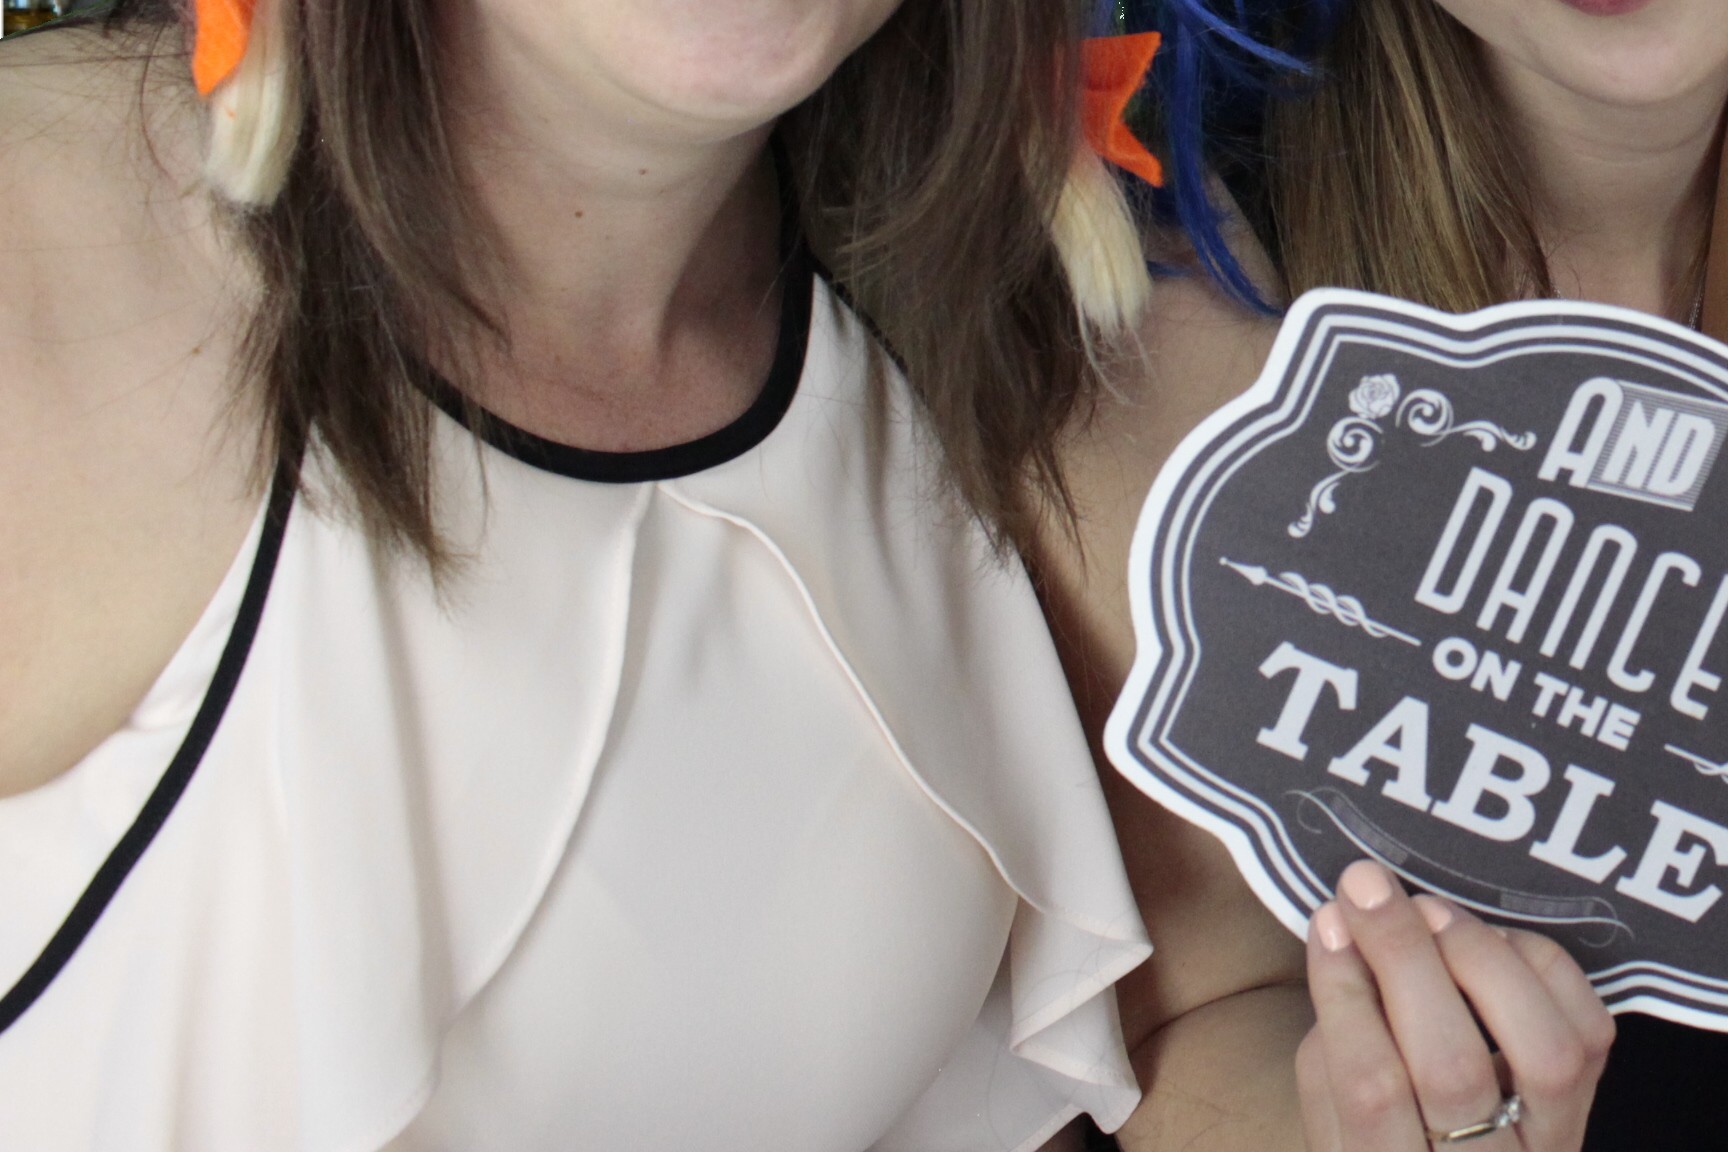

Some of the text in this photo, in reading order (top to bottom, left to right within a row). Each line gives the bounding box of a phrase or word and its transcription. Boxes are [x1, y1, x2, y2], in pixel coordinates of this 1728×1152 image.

[1537, 376, 1716, 496] AND
[1432, 636, 1642, 751] ON THE
